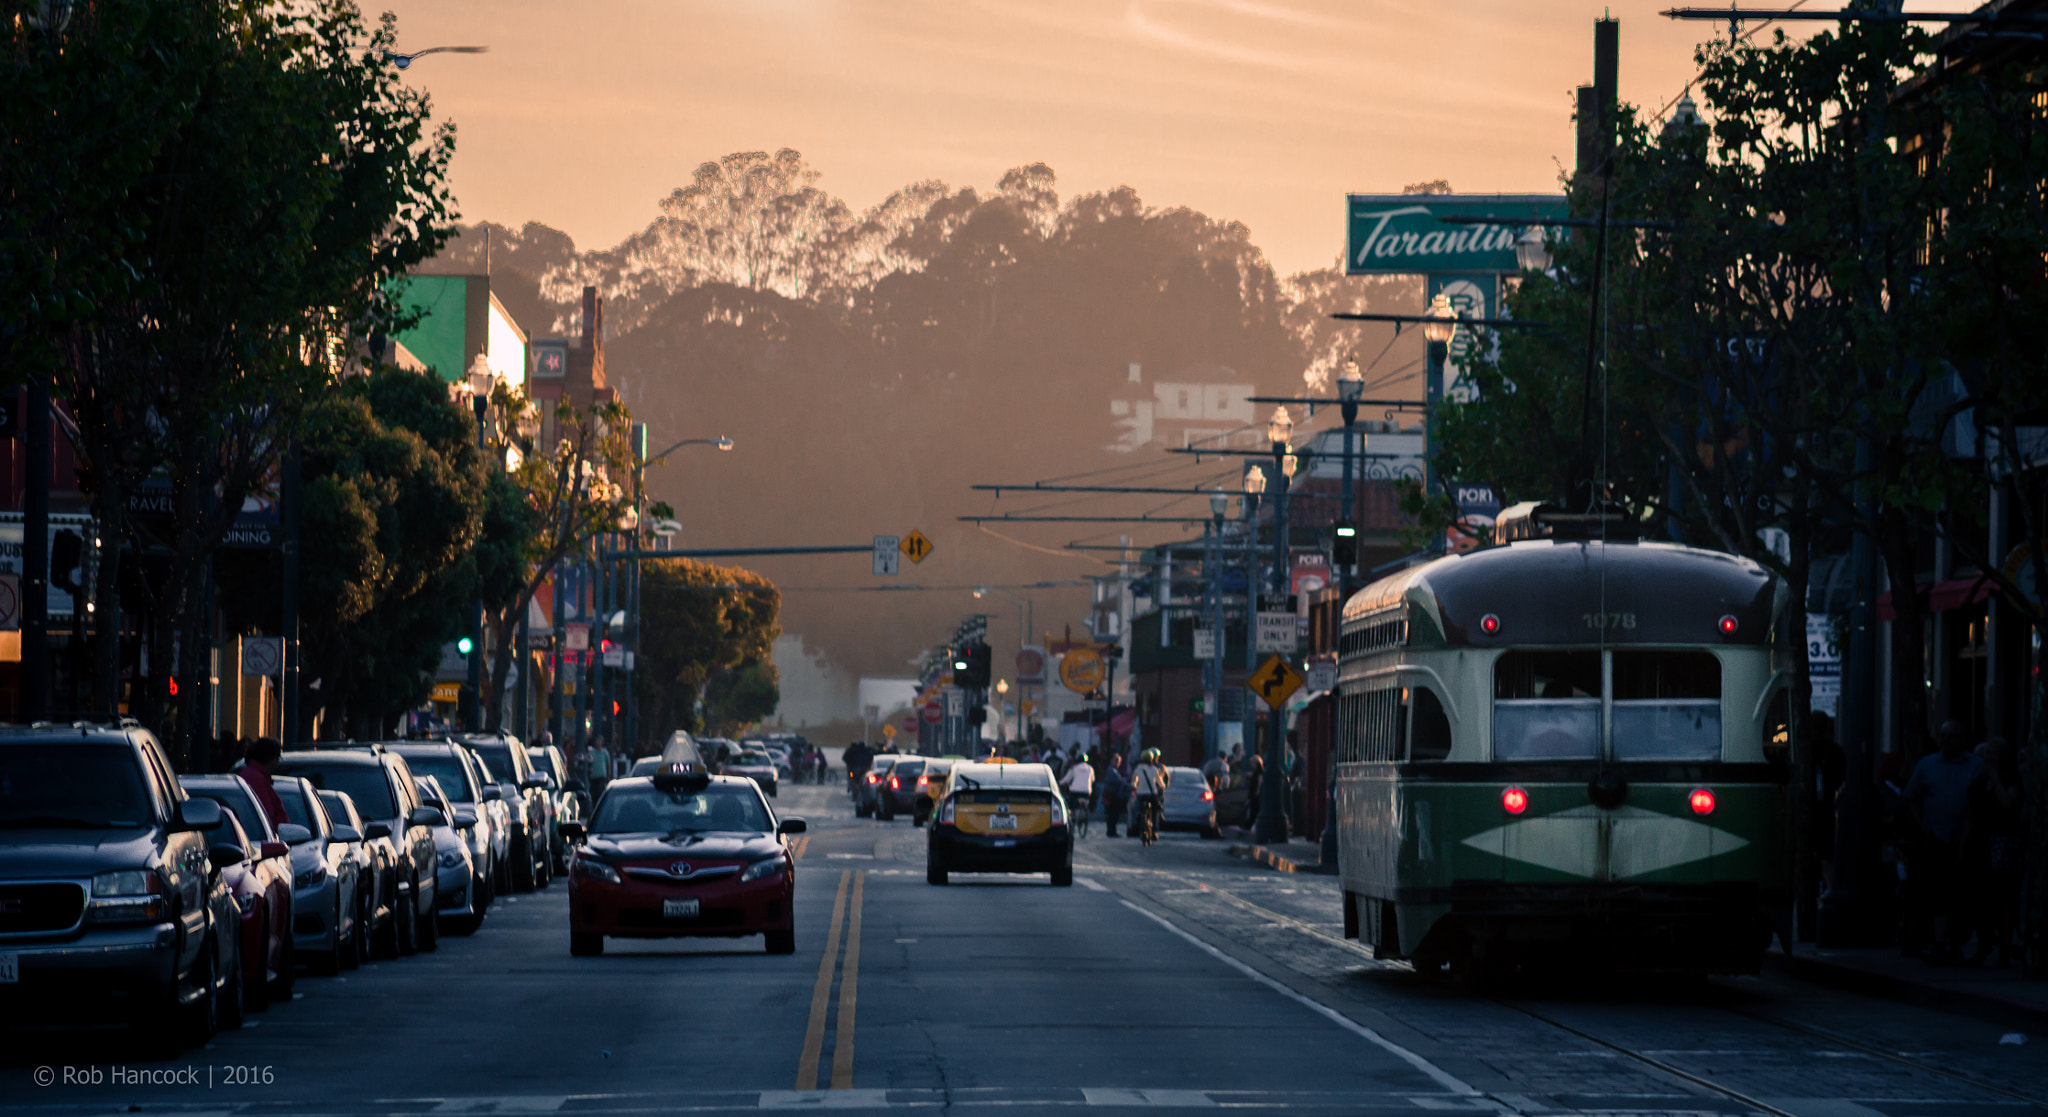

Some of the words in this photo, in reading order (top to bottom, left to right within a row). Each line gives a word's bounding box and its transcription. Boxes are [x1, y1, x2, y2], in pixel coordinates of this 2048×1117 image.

[1298, 554, 1323, 565] PORT
[1258, 616, 1295, 627] TRANSIT
[1582, 612, 1637, 629] 1078
[1263, 631, 1287, 641] ONLY
